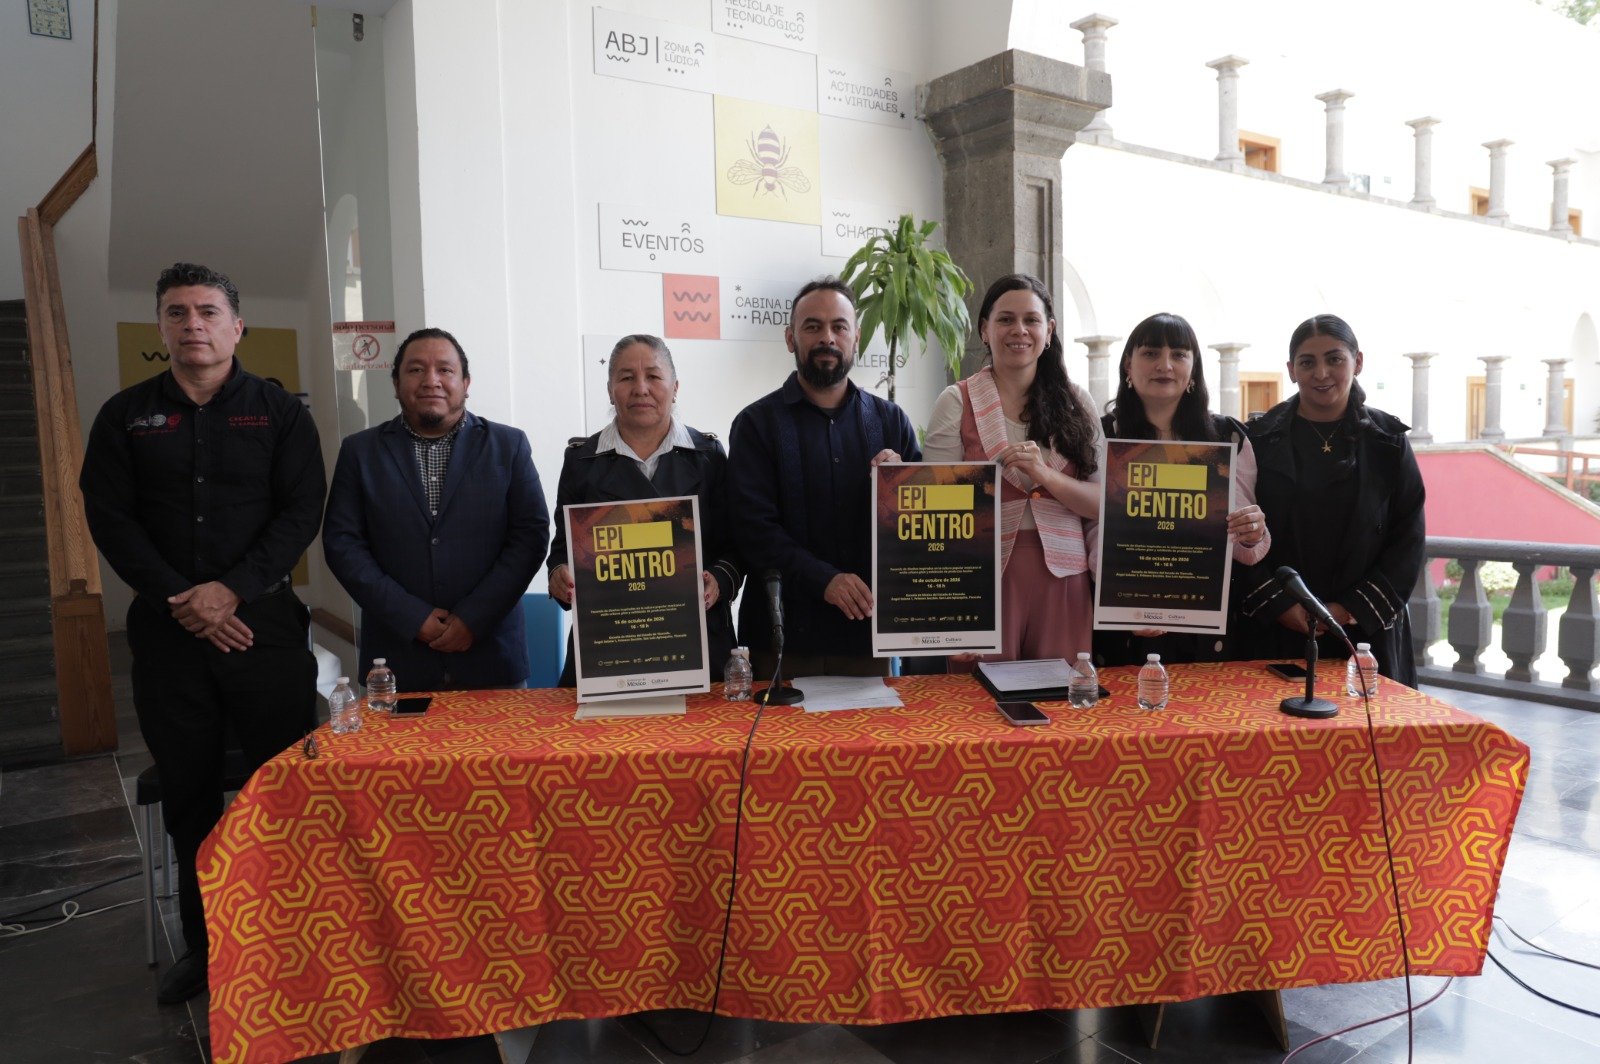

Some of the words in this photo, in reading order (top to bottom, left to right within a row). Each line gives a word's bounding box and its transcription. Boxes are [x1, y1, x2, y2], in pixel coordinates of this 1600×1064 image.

[725, 7, 804, 34] TECNOLÓGICO
[605, 31, 648, 56] ABJ
[664, 41, 691, 54] ZONA
[665, 52, 700, 67] LÚDICA
[831, 80, 898, 102] ACTIVIDADES
[845, 95, 898, 113] VIRTUALES
[622, 232, 705, 254] EVENTOS
[736, 297, 782, 309] CABINA
[752, 311, 791, 326] RADI
[1130, 464, 1157, 487] EPI
[900, 487, 927, 509] EPI
[1127, 491, 1207, 520] CENTRO
[898, 512, 975, 541] CENTRO
[1157, 520, 1175, 530] 2026
[595, 524, 624, 551] EPI
[928, 543, 945, 552] 2026
[595, 550, 675, 582] CENTRO
[628, 582, 646, 591] 2026
